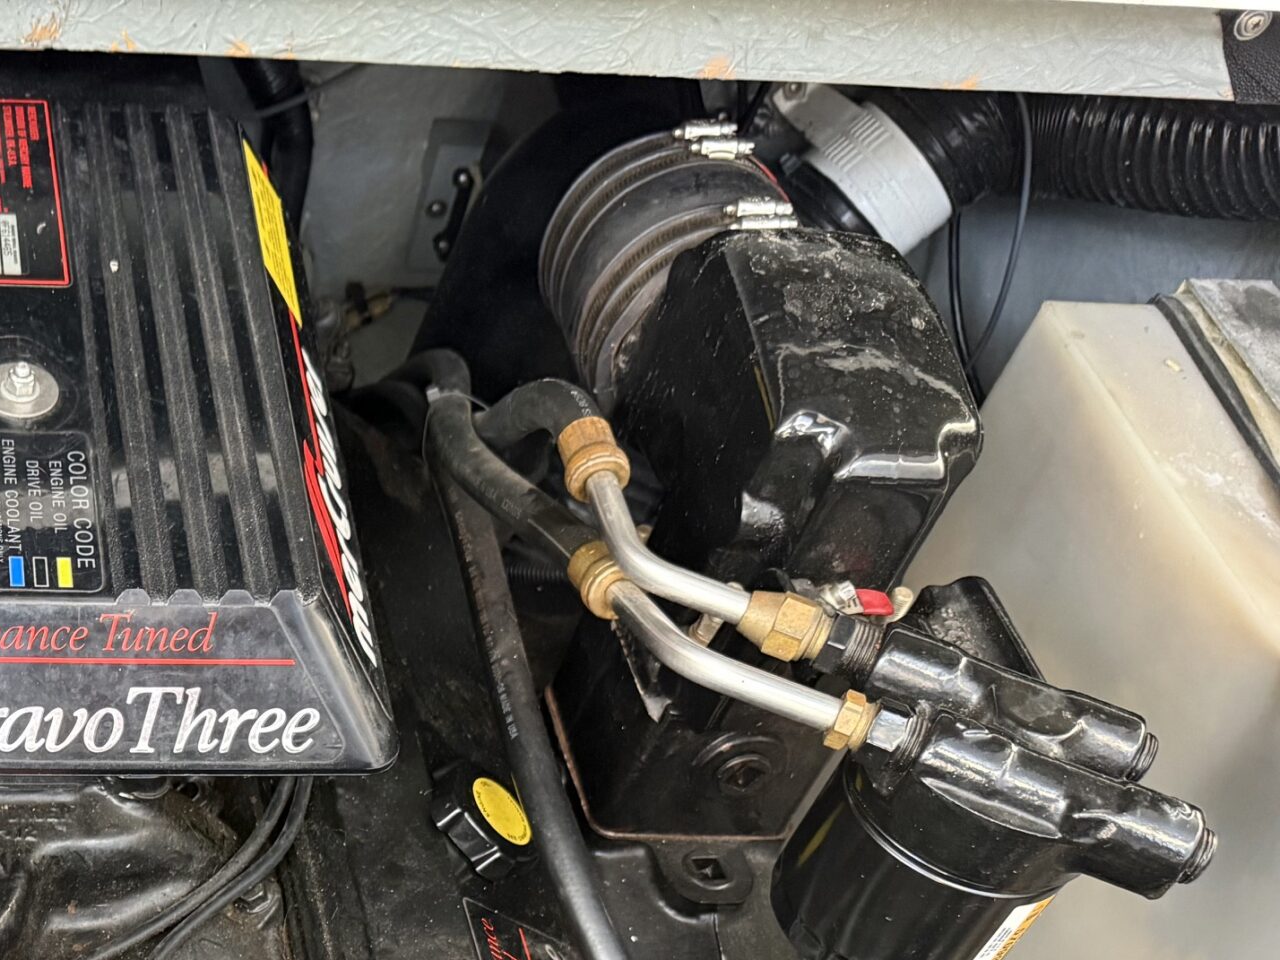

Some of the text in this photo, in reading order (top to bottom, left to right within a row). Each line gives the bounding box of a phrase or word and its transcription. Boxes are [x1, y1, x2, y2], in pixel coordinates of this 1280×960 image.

[1, 439, 22, 551] ENGINE COOLANT
[25, 460, 43, 522] DRIVE OIL
[48, 460, 68, 534] ENGINE OIL
[67, 450, 96, 569] COLOR CODE
[97, 612, 218, 652] Tuned
